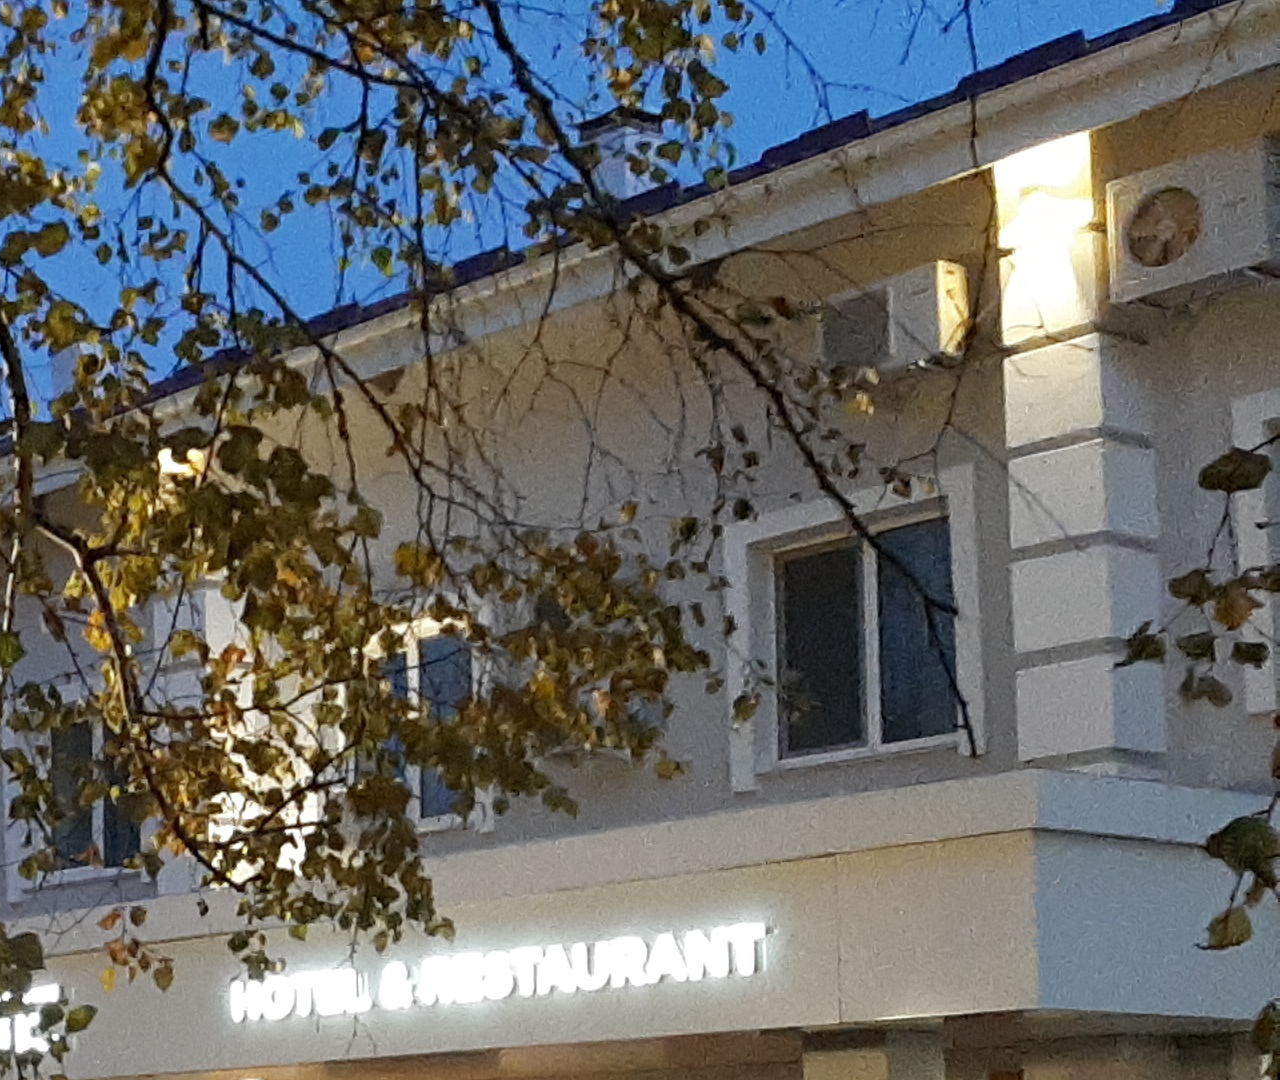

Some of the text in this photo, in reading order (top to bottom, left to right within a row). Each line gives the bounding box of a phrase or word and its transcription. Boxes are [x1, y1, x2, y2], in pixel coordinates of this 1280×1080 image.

[230, 923, 766, 1022] HOTEL & RESTAURANT
